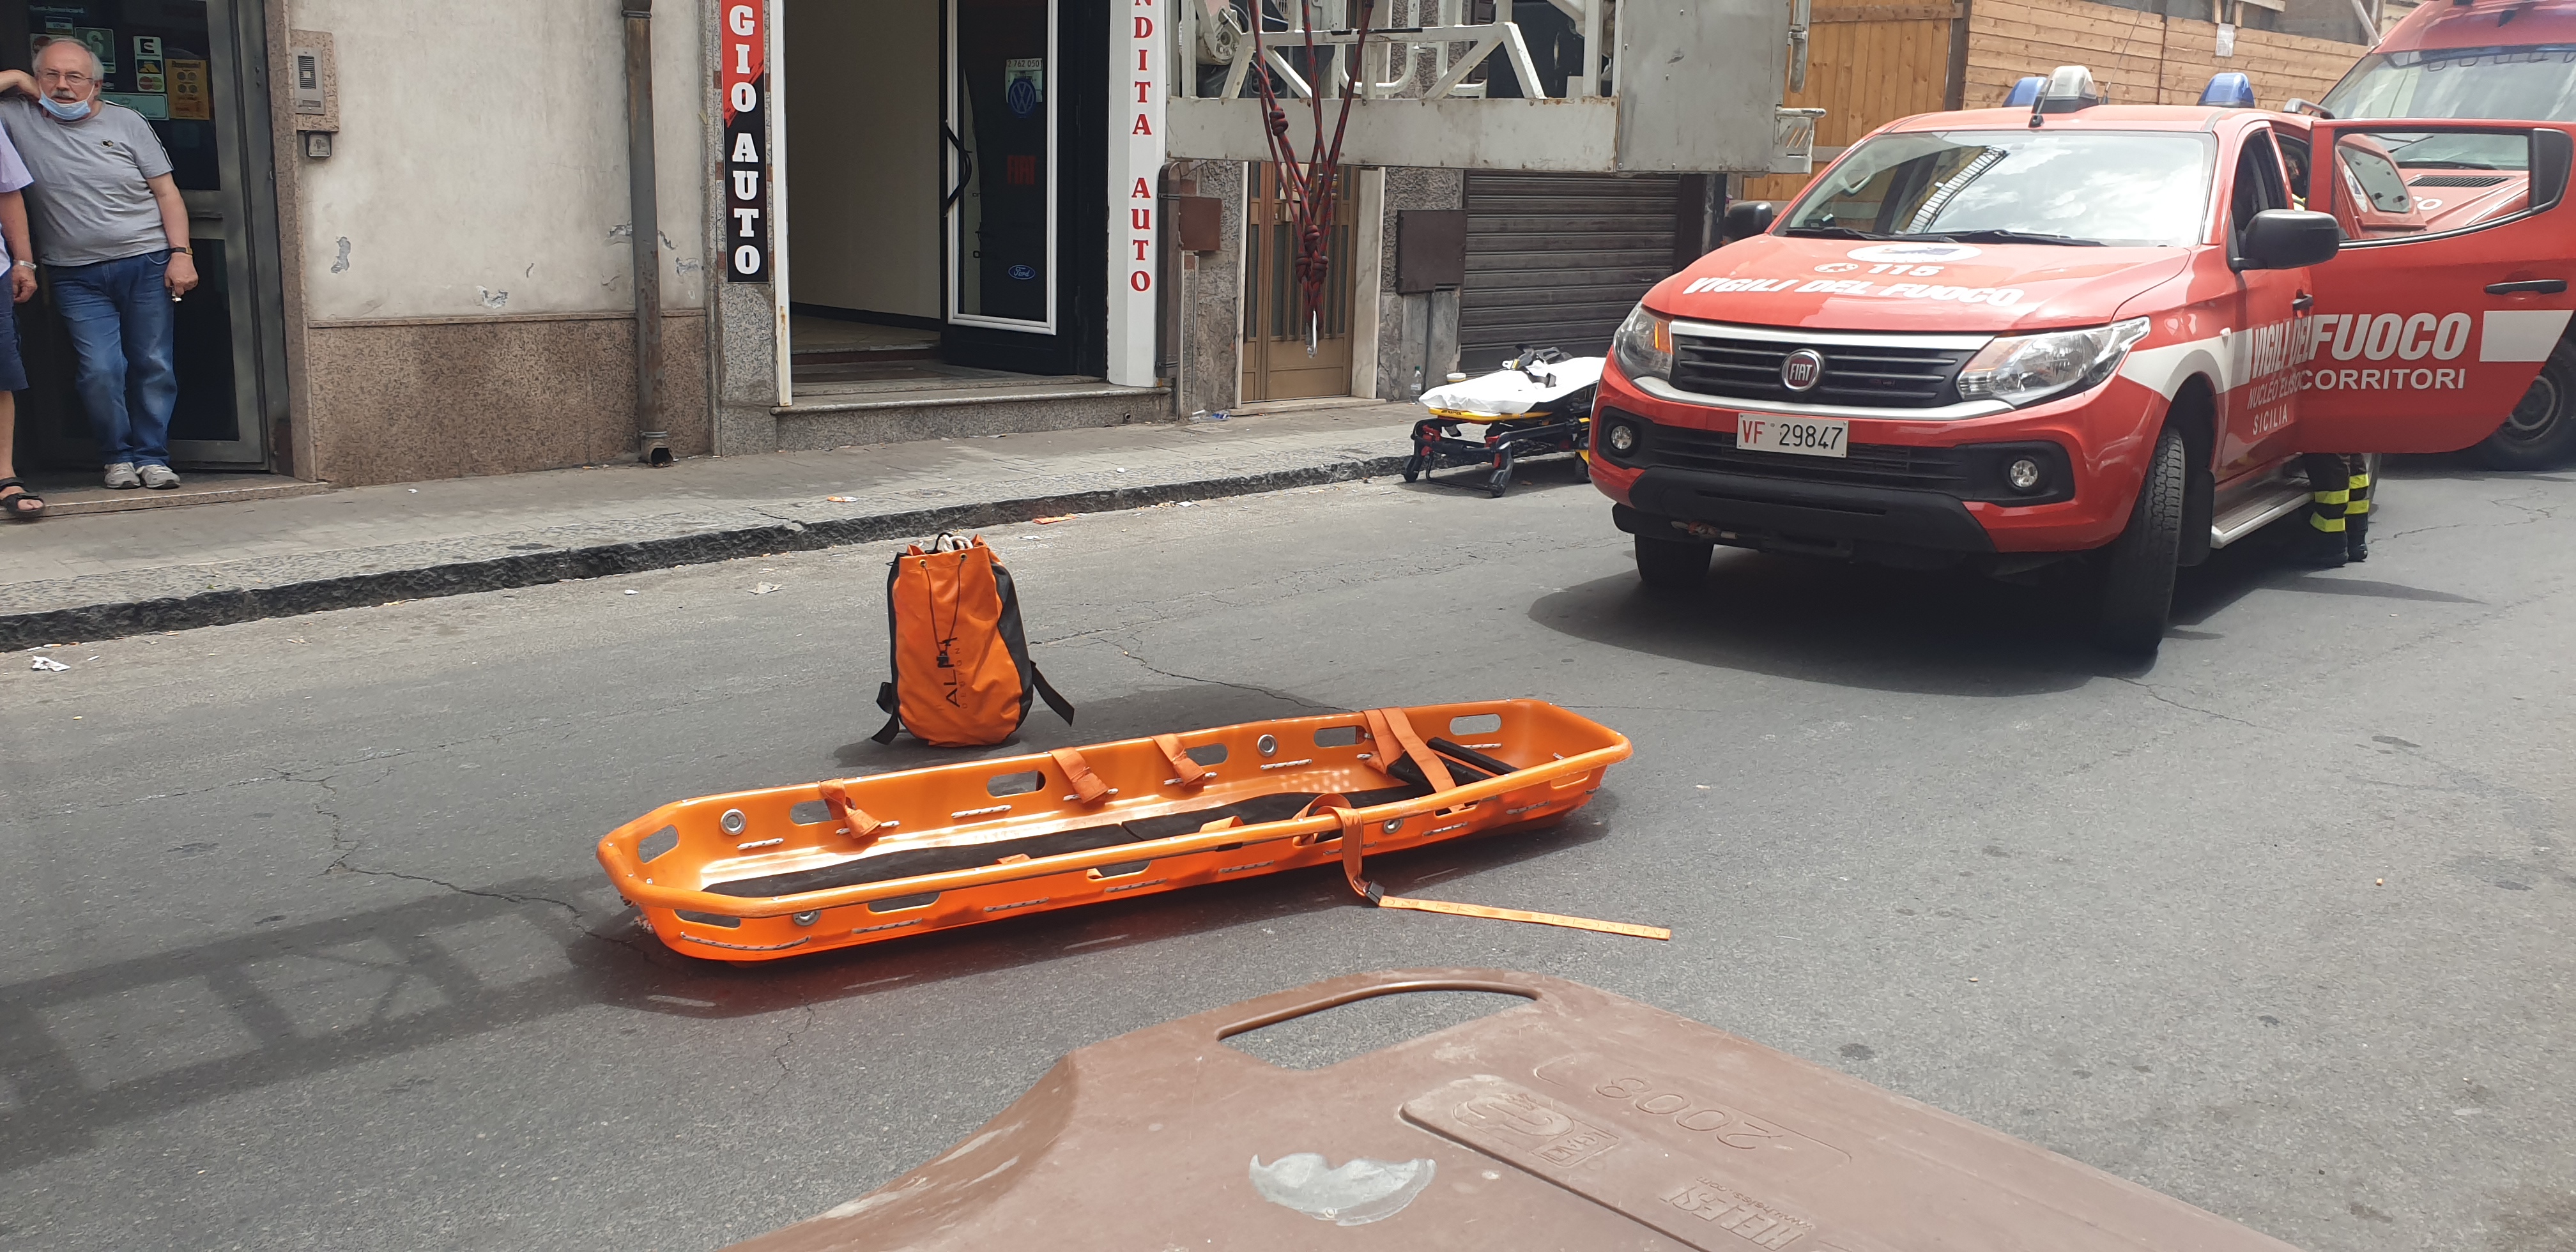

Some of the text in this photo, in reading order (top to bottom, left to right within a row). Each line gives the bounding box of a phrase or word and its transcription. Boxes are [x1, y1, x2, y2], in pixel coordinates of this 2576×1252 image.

[729, 5, 760, 275] GIO AUTO
[1130, 0, 1153, 292] DITA AUTO
[1013, 266, 1031, 277] Ford
[1867, 263, 1945, 277] 115
[1683, 277, 2025, 307] VIGILI DEL FUOCO
[2252, 321, 2290, 379] VIGILI
[2308, 312, 2471, 361] FUOCO
[1790, 363, 1813, 381] FIAT
[2247, 379, 2279, 410] NUCLEO
[1742, 420, 1843, 450] VF 29847
[2253, 404, 2288, 435] SICILIA
[1659, 1186, 1804, 1251] HELESI
